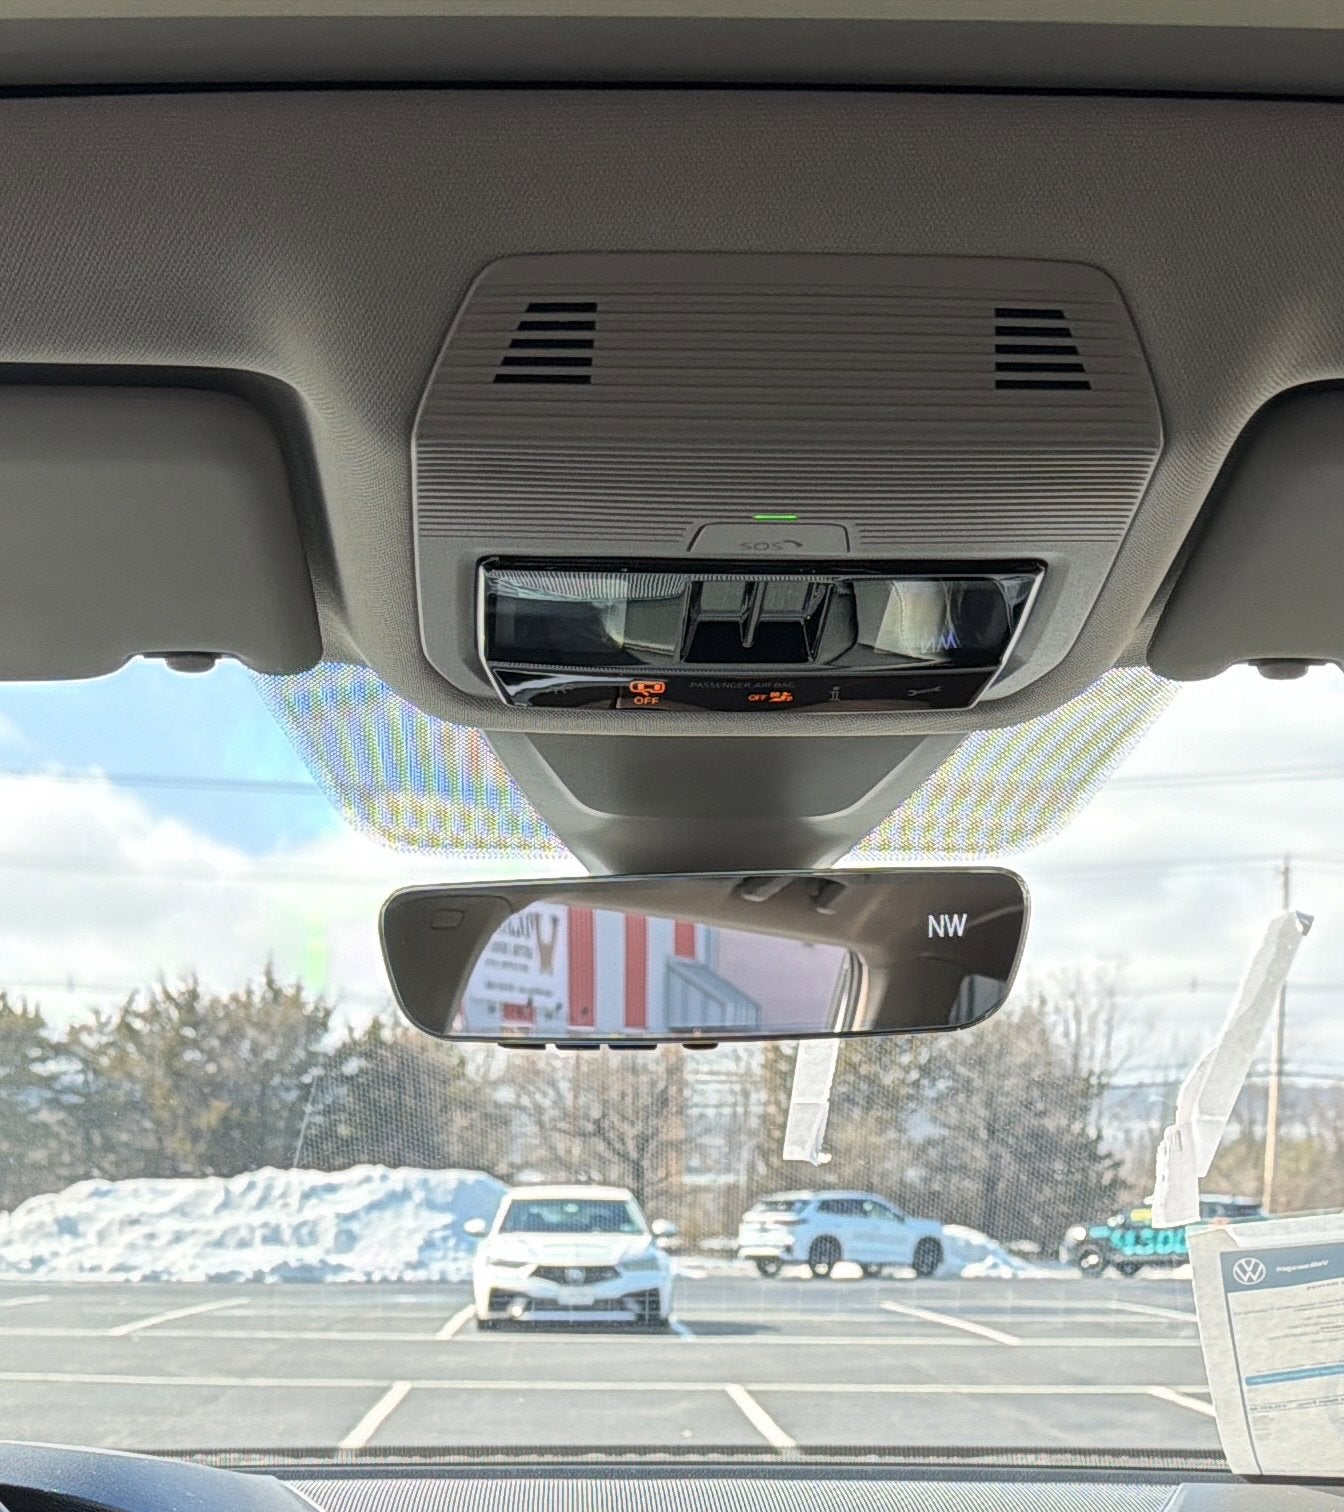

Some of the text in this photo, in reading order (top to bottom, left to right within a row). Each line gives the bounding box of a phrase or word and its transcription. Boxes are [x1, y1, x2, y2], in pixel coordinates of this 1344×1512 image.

[740, 541, 784, 551] SOS
[633, 696, 660, 705] OFF
[927, 913, 969, 938] NW
